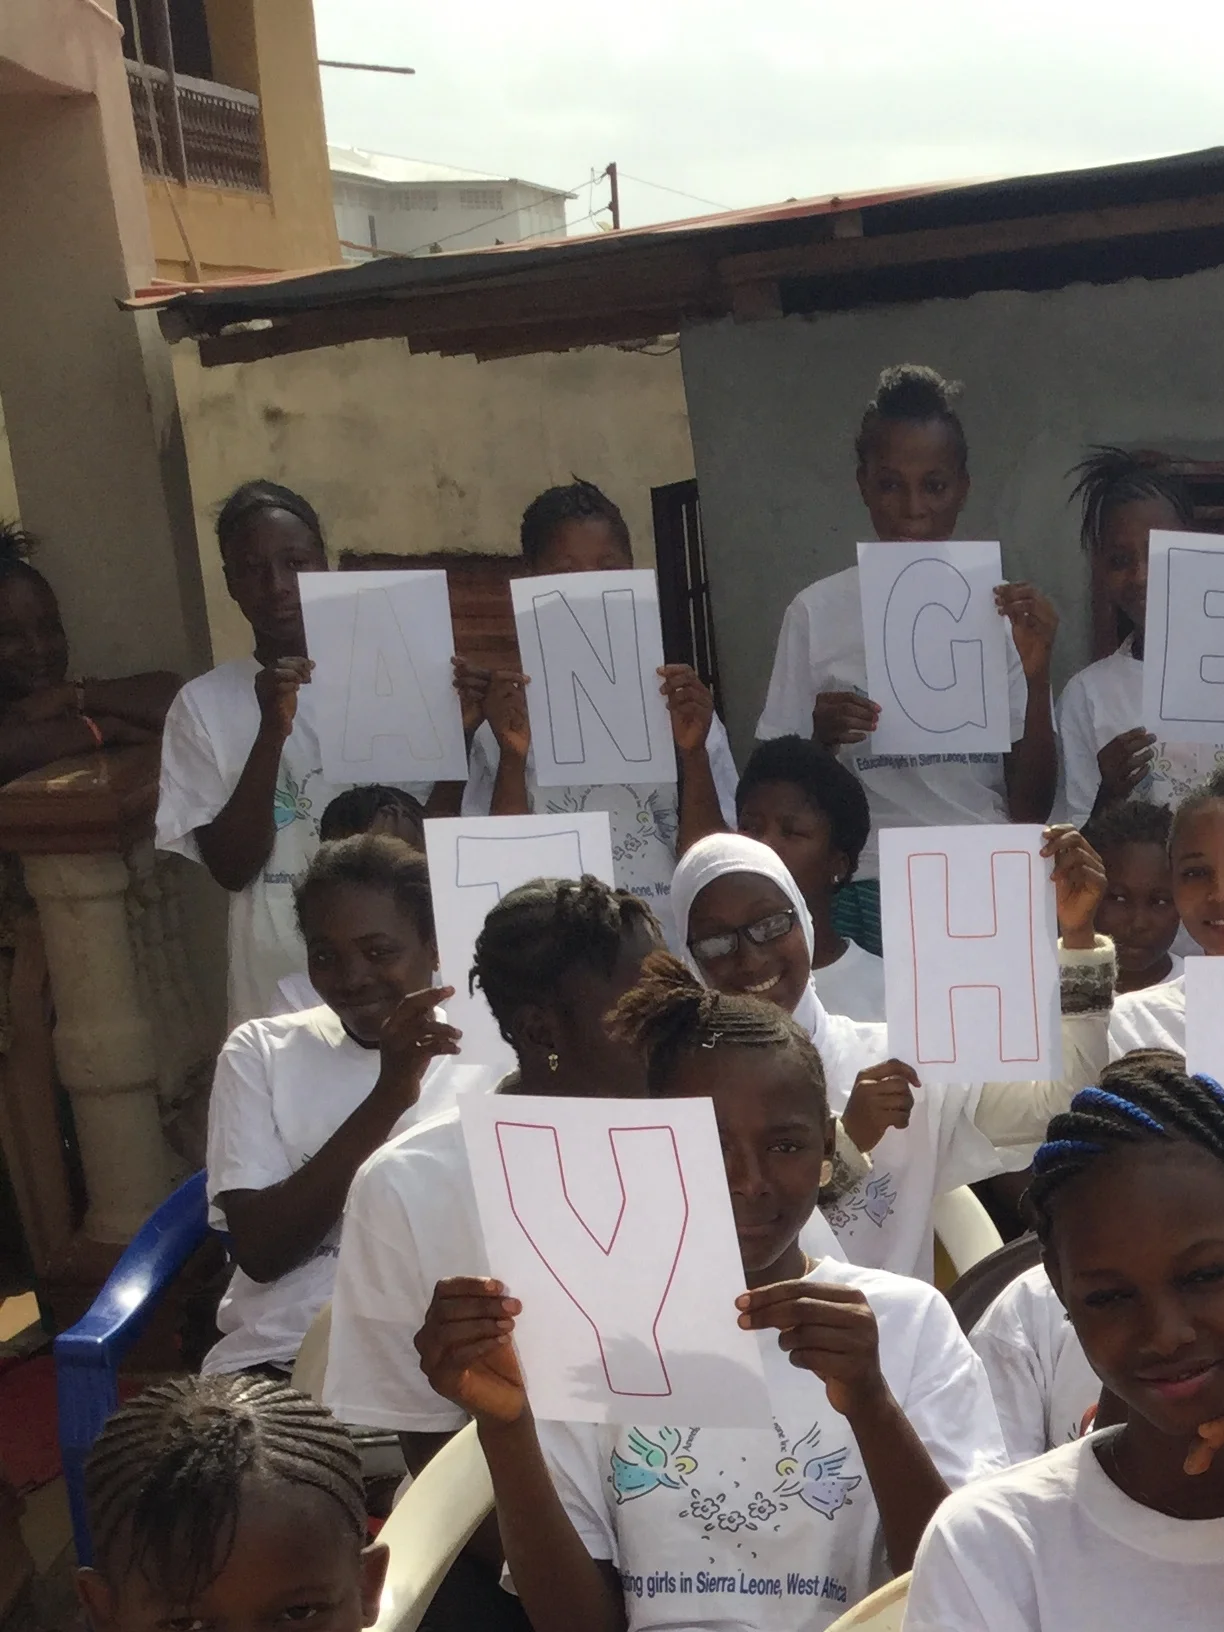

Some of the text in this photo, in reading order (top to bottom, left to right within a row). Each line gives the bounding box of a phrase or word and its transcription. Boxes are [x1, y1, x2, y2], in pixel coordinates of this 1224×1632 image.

[341, 587, 444, 763] A
[532, 588, 652, 764] N
[883, 557, 988, 733] G
[907, 850, 1041, 1064] H
[495, 1121, 690, 1397] Y
[647, 1571, 676, 1598] girls
[680, 1571, 693, 1593] in
[696, 1571, 736, 1594] Sierra
[739, 1572, 783, 1599] Leone,
[786, 1572, 820, 1597] West
